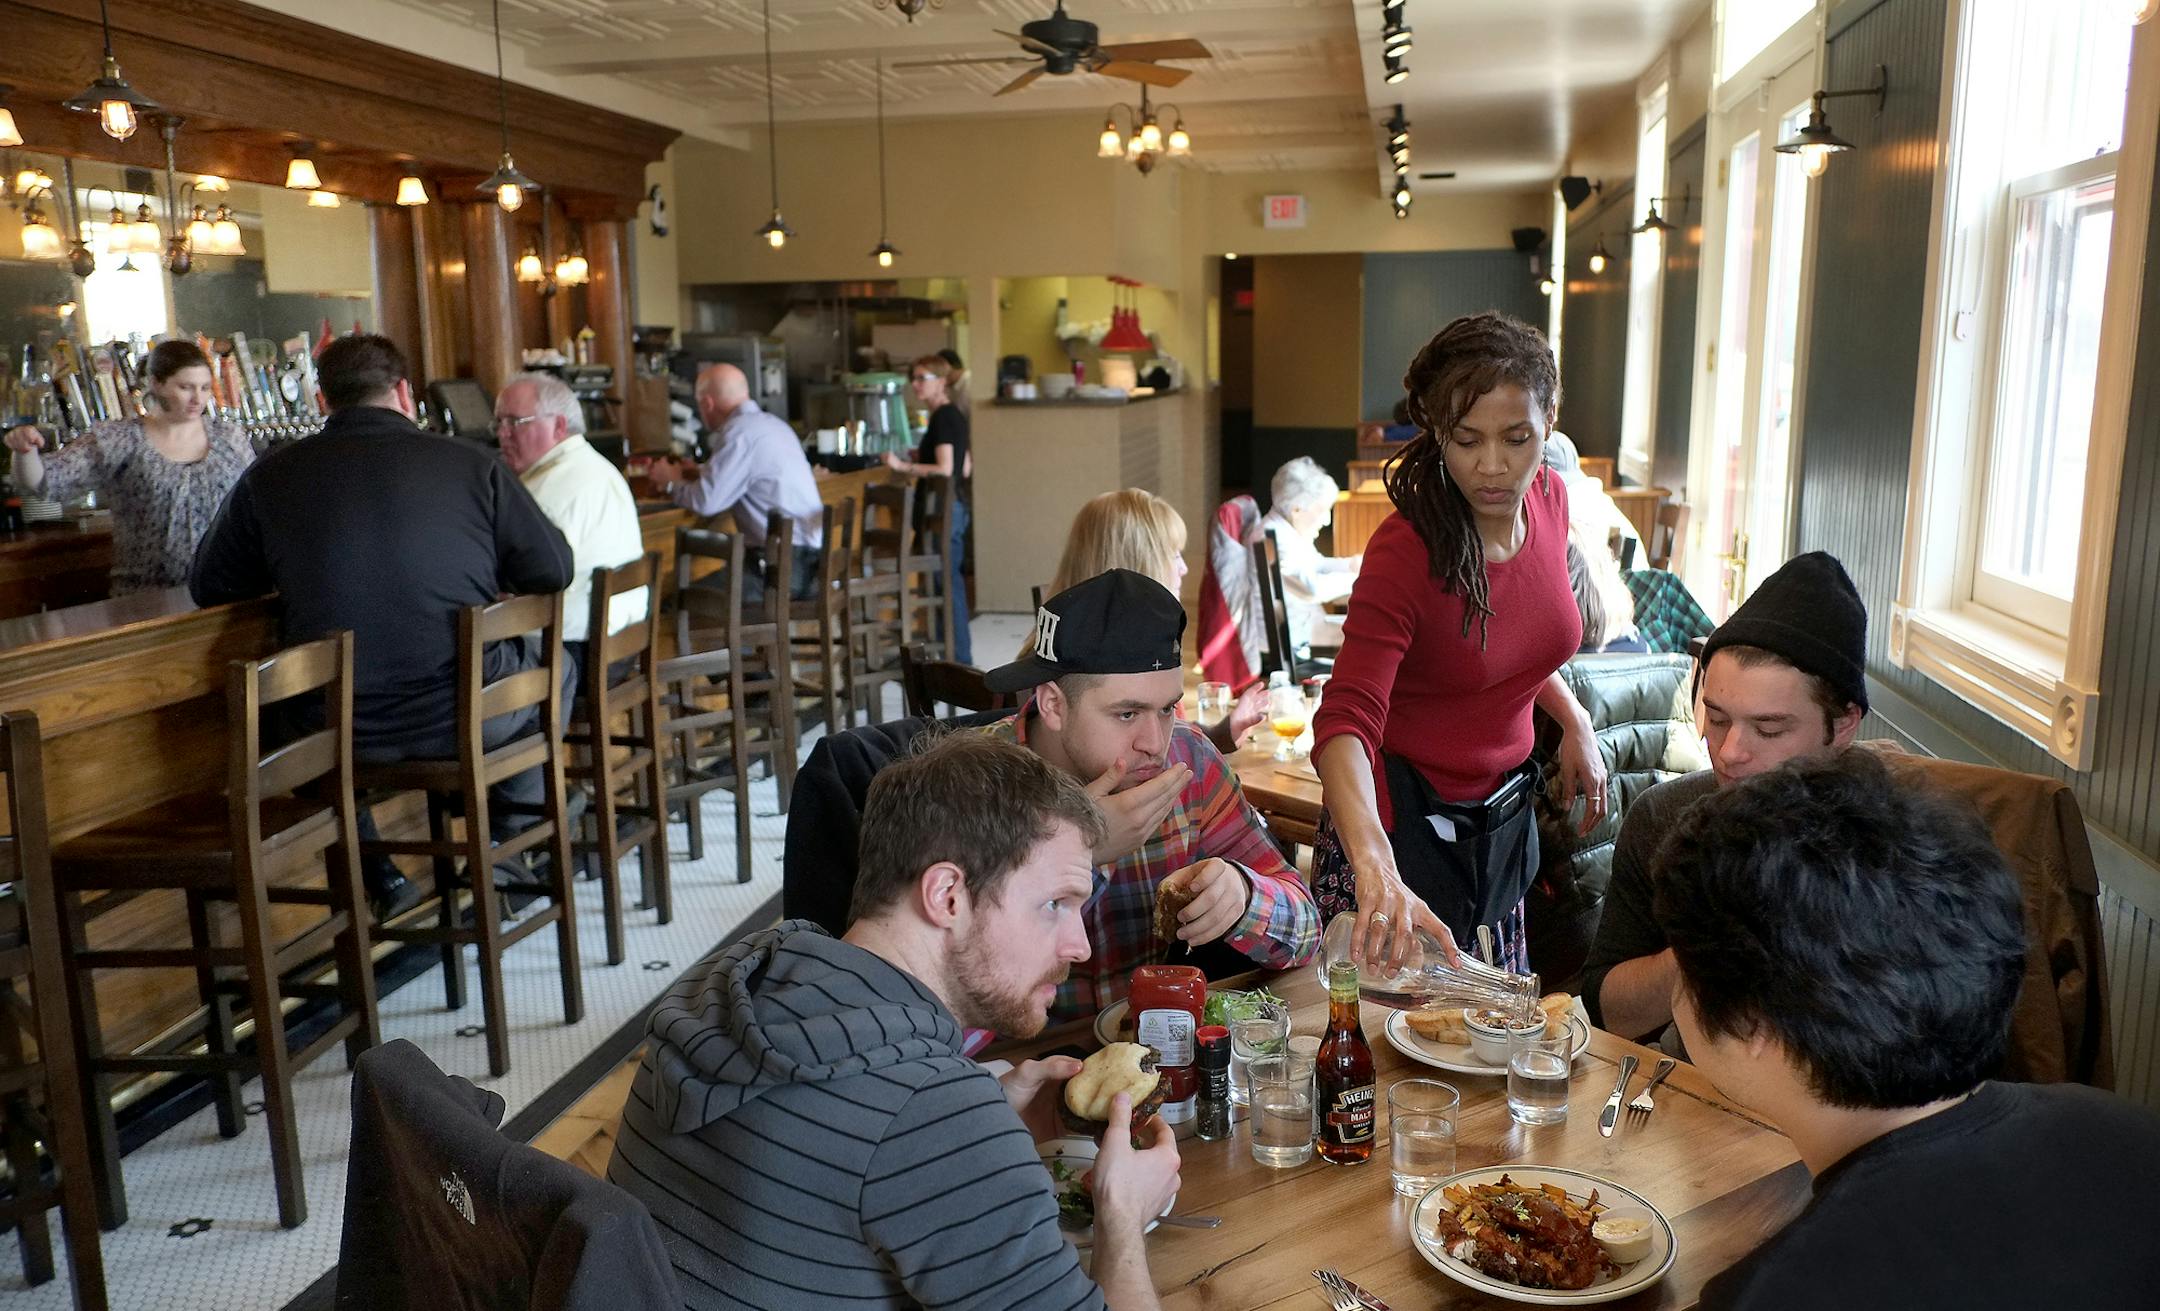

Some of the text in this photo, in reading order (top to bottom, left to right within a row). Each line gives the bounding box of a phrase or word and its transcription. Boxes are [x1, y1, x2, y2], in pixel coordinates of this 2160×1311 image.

[1271, 198, 1298, 219] EXIT
[1345, 1089, 1375, 1104] HEINZ
[1350, 1110, 1371, 1122] MALT
